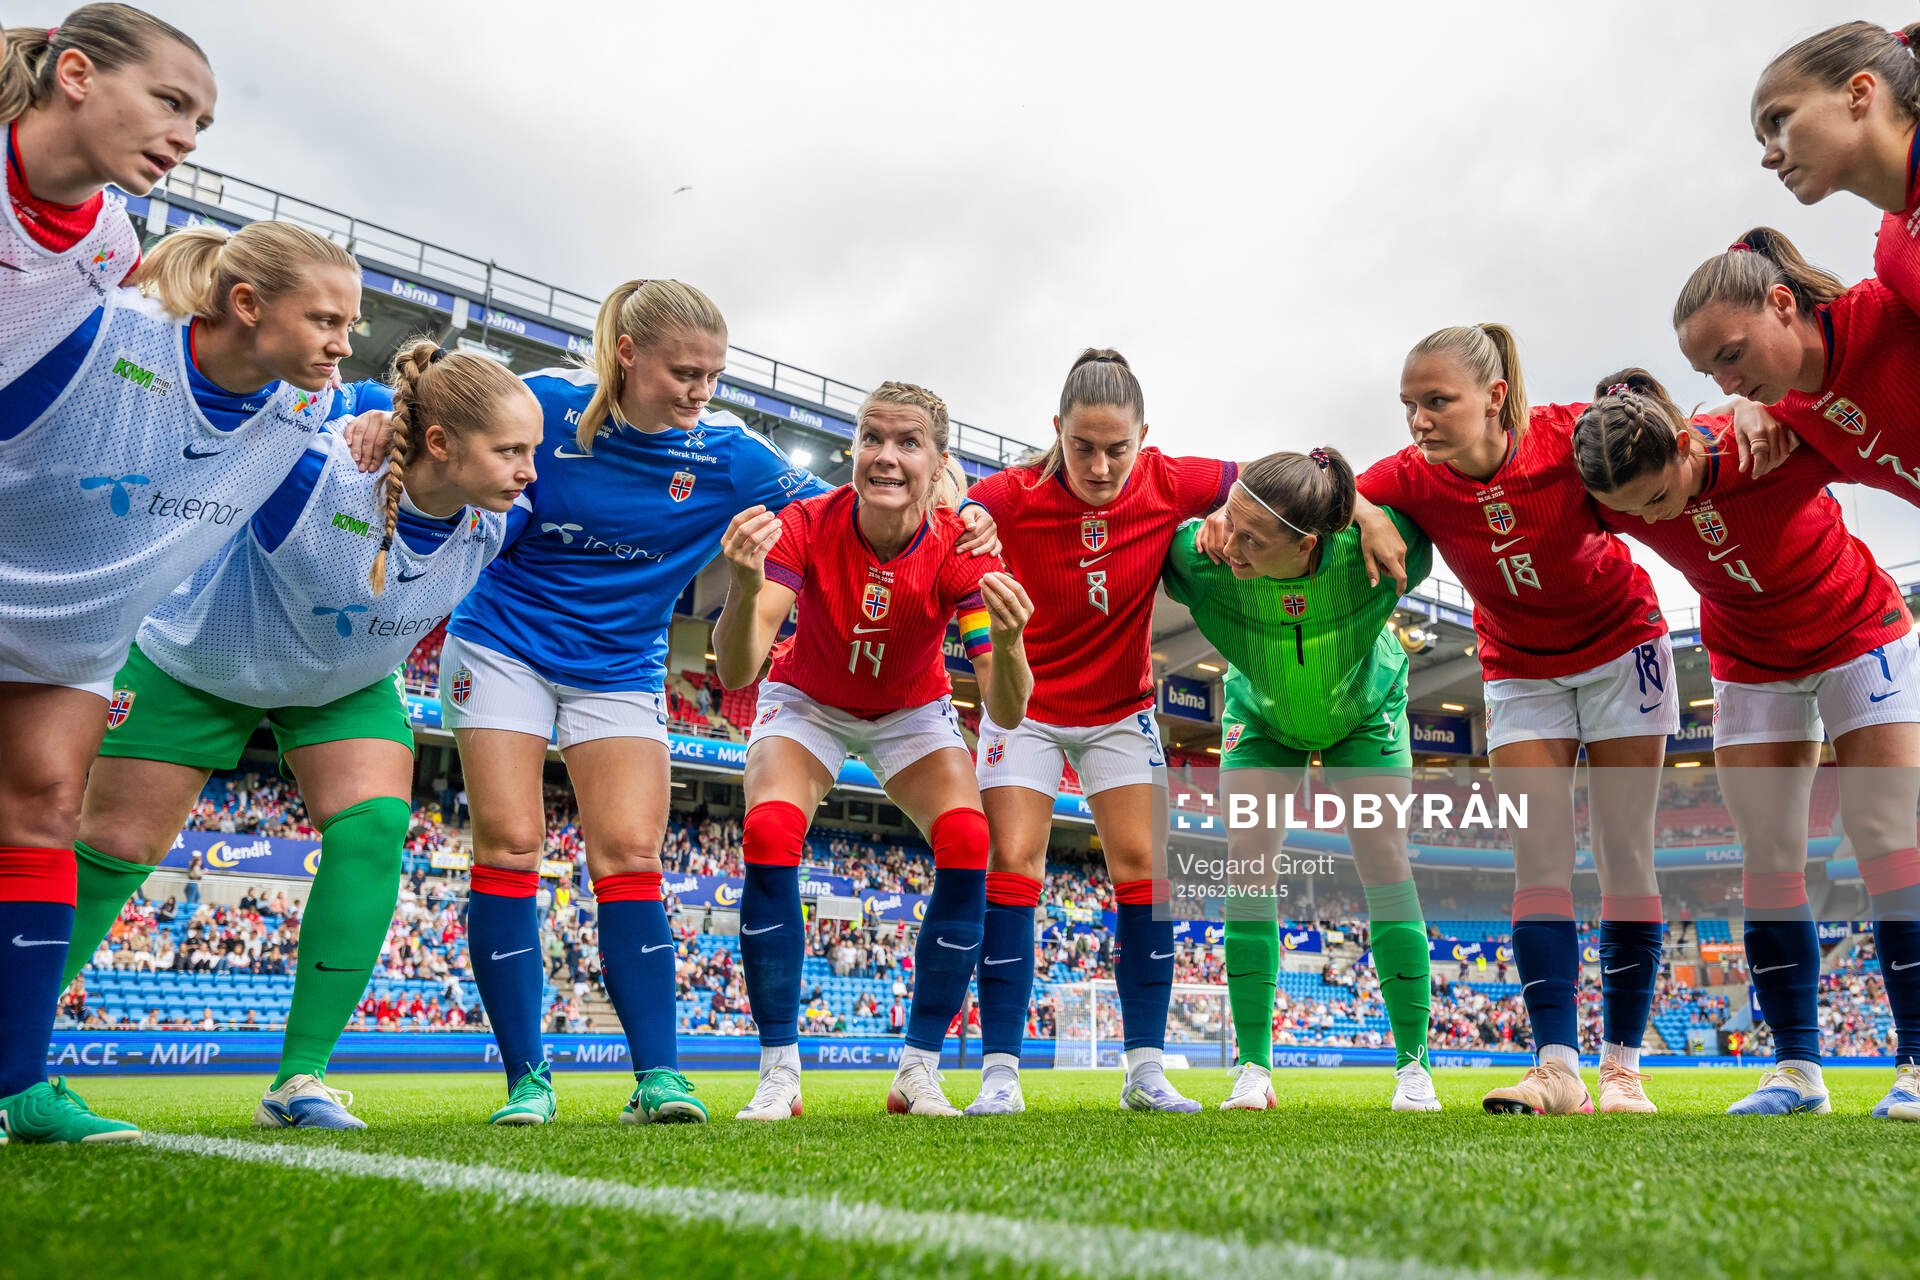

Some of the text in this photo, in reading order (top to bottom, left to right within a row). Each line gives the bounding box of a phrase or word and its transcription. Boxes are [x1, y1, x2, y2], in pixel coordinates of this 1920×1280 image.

[391, 278, 438, 307] bama
[112, 357, 173, 389] KIWI mini
[150, 385, 168, 397] pris
[720, 383, 756, 407] bama
[241, 402, 260, 413] Nor
[563, 407, 582, 426] KI
[789, 405, 823, 428] bama
[668, 448, 718, 464] Norsk Tipping
[148, 491, 243, 527] telenor
[331, 511, 371, 537] KIWI
[1495, 553, 1542, 597] 18
[1721, 560, 1763, 593] 4
[1086, 570, 1109, 617] 8
[1292, 623, 1305, 667] 1
[849, 640, 885, 678] 14
[1631, 644, 1664, 696] 18
[1168, 685, 1206, 710] bama
[1413, 723, 1455, 744] bama
[1673, 724, 1714, 741] bam
[669, 740, 705, 758] EACE
[221, 839, 272, 862] Bendit
[799, 880, 832, 895] ama
[1819, 923, 1850, 939] bam
[46, 1042, 119, 1066] EACE
[818, 1045, 871, 1063] PEACE
